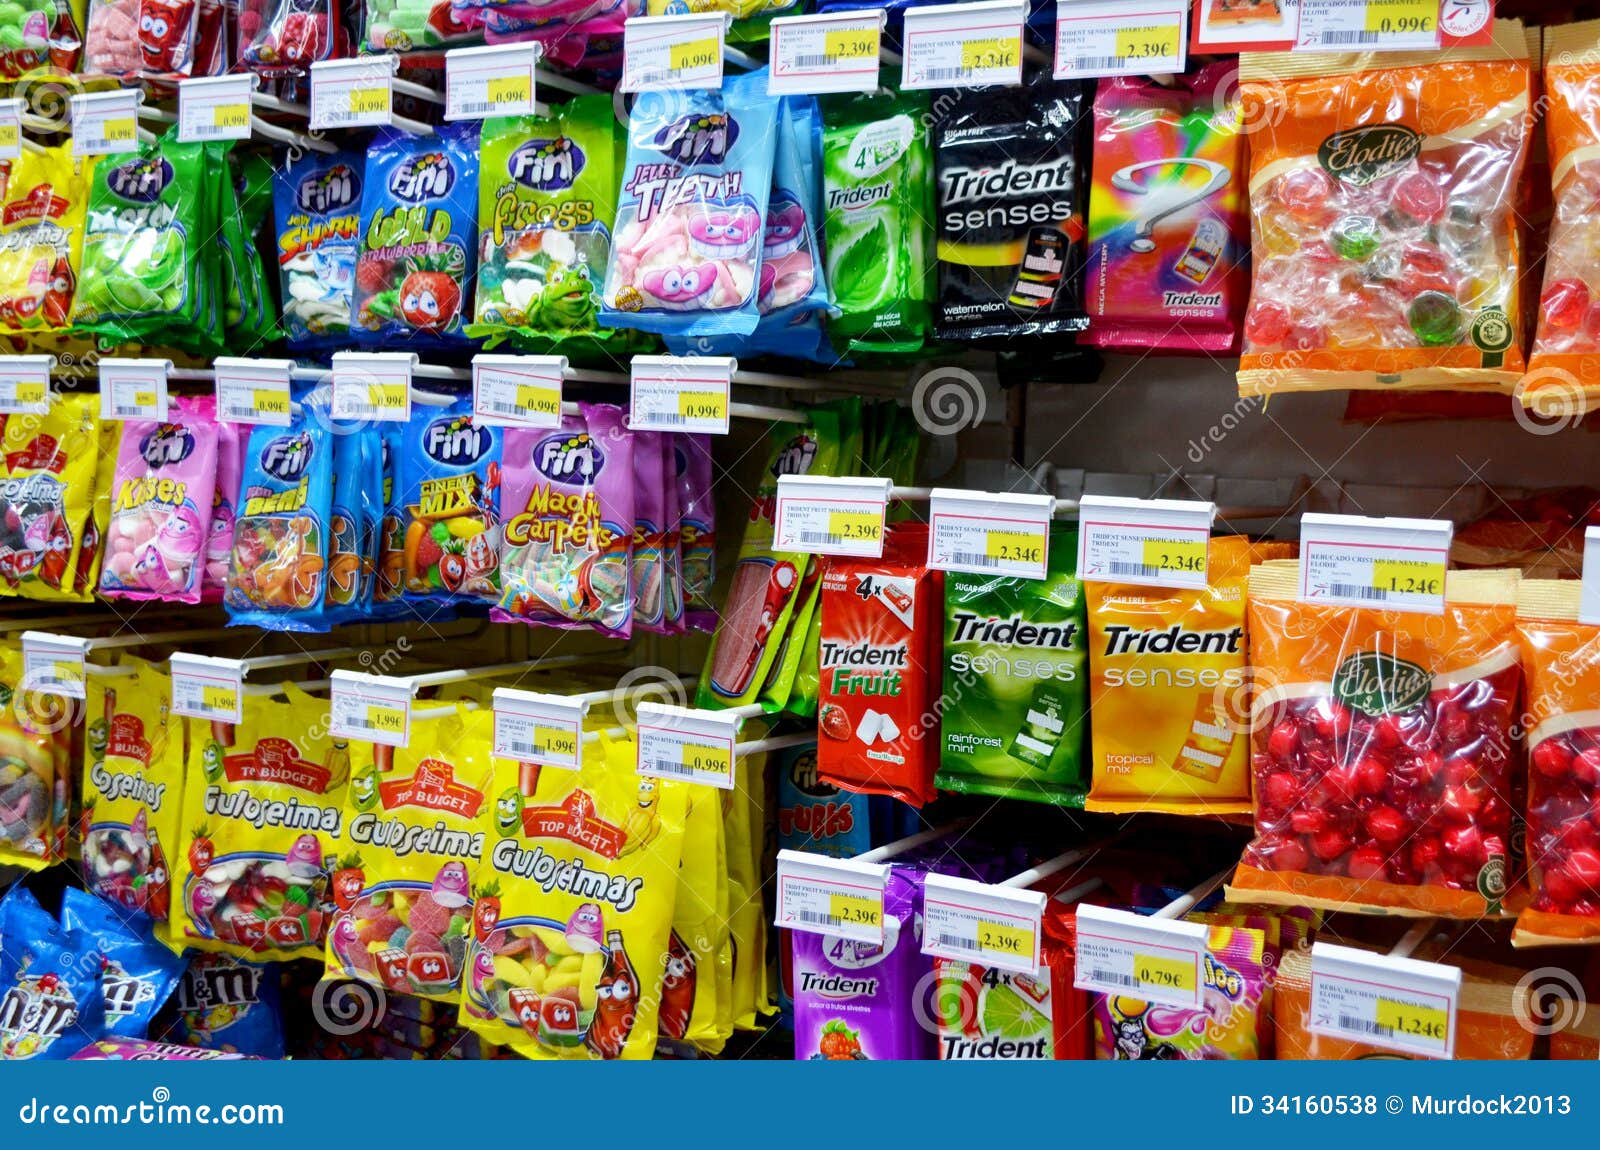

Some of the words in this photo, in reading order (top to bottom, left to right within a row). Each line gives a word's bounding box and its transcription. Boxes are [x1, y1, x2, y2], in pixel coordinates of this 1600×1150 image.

[1380, 16, 1432, 34] 0,99€
[838, 41, 875, 57] 2,39€
[1127, 42, 1171, 58] 2,39€
[681, 52, 715, 69] 0,99€
[974, 52, 1014, 69] 2,34€
[496, 90, 526, 104] 0,99€
[944, 129, 967, 138] SUGAR
[968, 127, 984, 136] FREE
[511, 136, 573, 183] Fini
[393, 154, 449, 198] Fini
[943, 157, 1072, 203] Trident
[302, 164, 352, 210] Fini
[828, 182, 893, 210] Trident
[945, 200, 1073, 231] senses
[1099, 243, 1109, 290] MYSTERY
[1163, 292, 1222, 306] Trident
[943, 302, 1005, 315] watermelon
[1169, 307, 1215, 318] senses
[258, 400, 286, 414] 0,99€
[377, 395, 405, 409] 0,99€
[527, 398, 558, 414] 0,99€
[686, 404, 721, 419] 0,99€
[428, 420, 482, 461] Fini
[420, 475, 478, 497] CINEMA
[419, 490, 475, 516] MIX
[843, 524, 881, 539] 2,39€
[1000, 545, 1041, 563] 2,34€
[1160, 554, 1206, 572] 2,34€
[856, 576, 873, 600] 4
[955, 582, 977, 592] SUGAR
[1391, 576, 1440, 595] 1,24€
[950, 613, 1079, 648] Trident
[1104, 624, 1243, 656] Trident
[822, 642, 908, 667] Trident
[950, 651, 1076, 682] senses
[831, 668, 903, 697] Fruit
[1103, 666, 1244, 688] senses
[376, 713, 401, 727] 1,99€
[546, 738, 576, 754] 1,99€
[948, 732, 1002, 748] rainforest
[948, 742, 974, 754] mint
[694, 756, 729, 773] 0,99€
[1106, 752, 1153, 766] tropical
[260, 766, 318, 788] BUDGET
[1106, 764, 1131, 774] mix
[539, 822, 565, 835] TOP
[492, 838, 644, 911] Guloseimas
[842, 907, 879, 925] 2,39€
[983, 932, 1022, 952] 2,39€
[800, 971, 879, 996] Trident
[982, 966, 1000, 990] 4
[1140, 967, 1183, 987] 0,79€
[1397, 1015, 1445, 1040] 1,24€
[943, 1036, 1049, 1060] Trident
